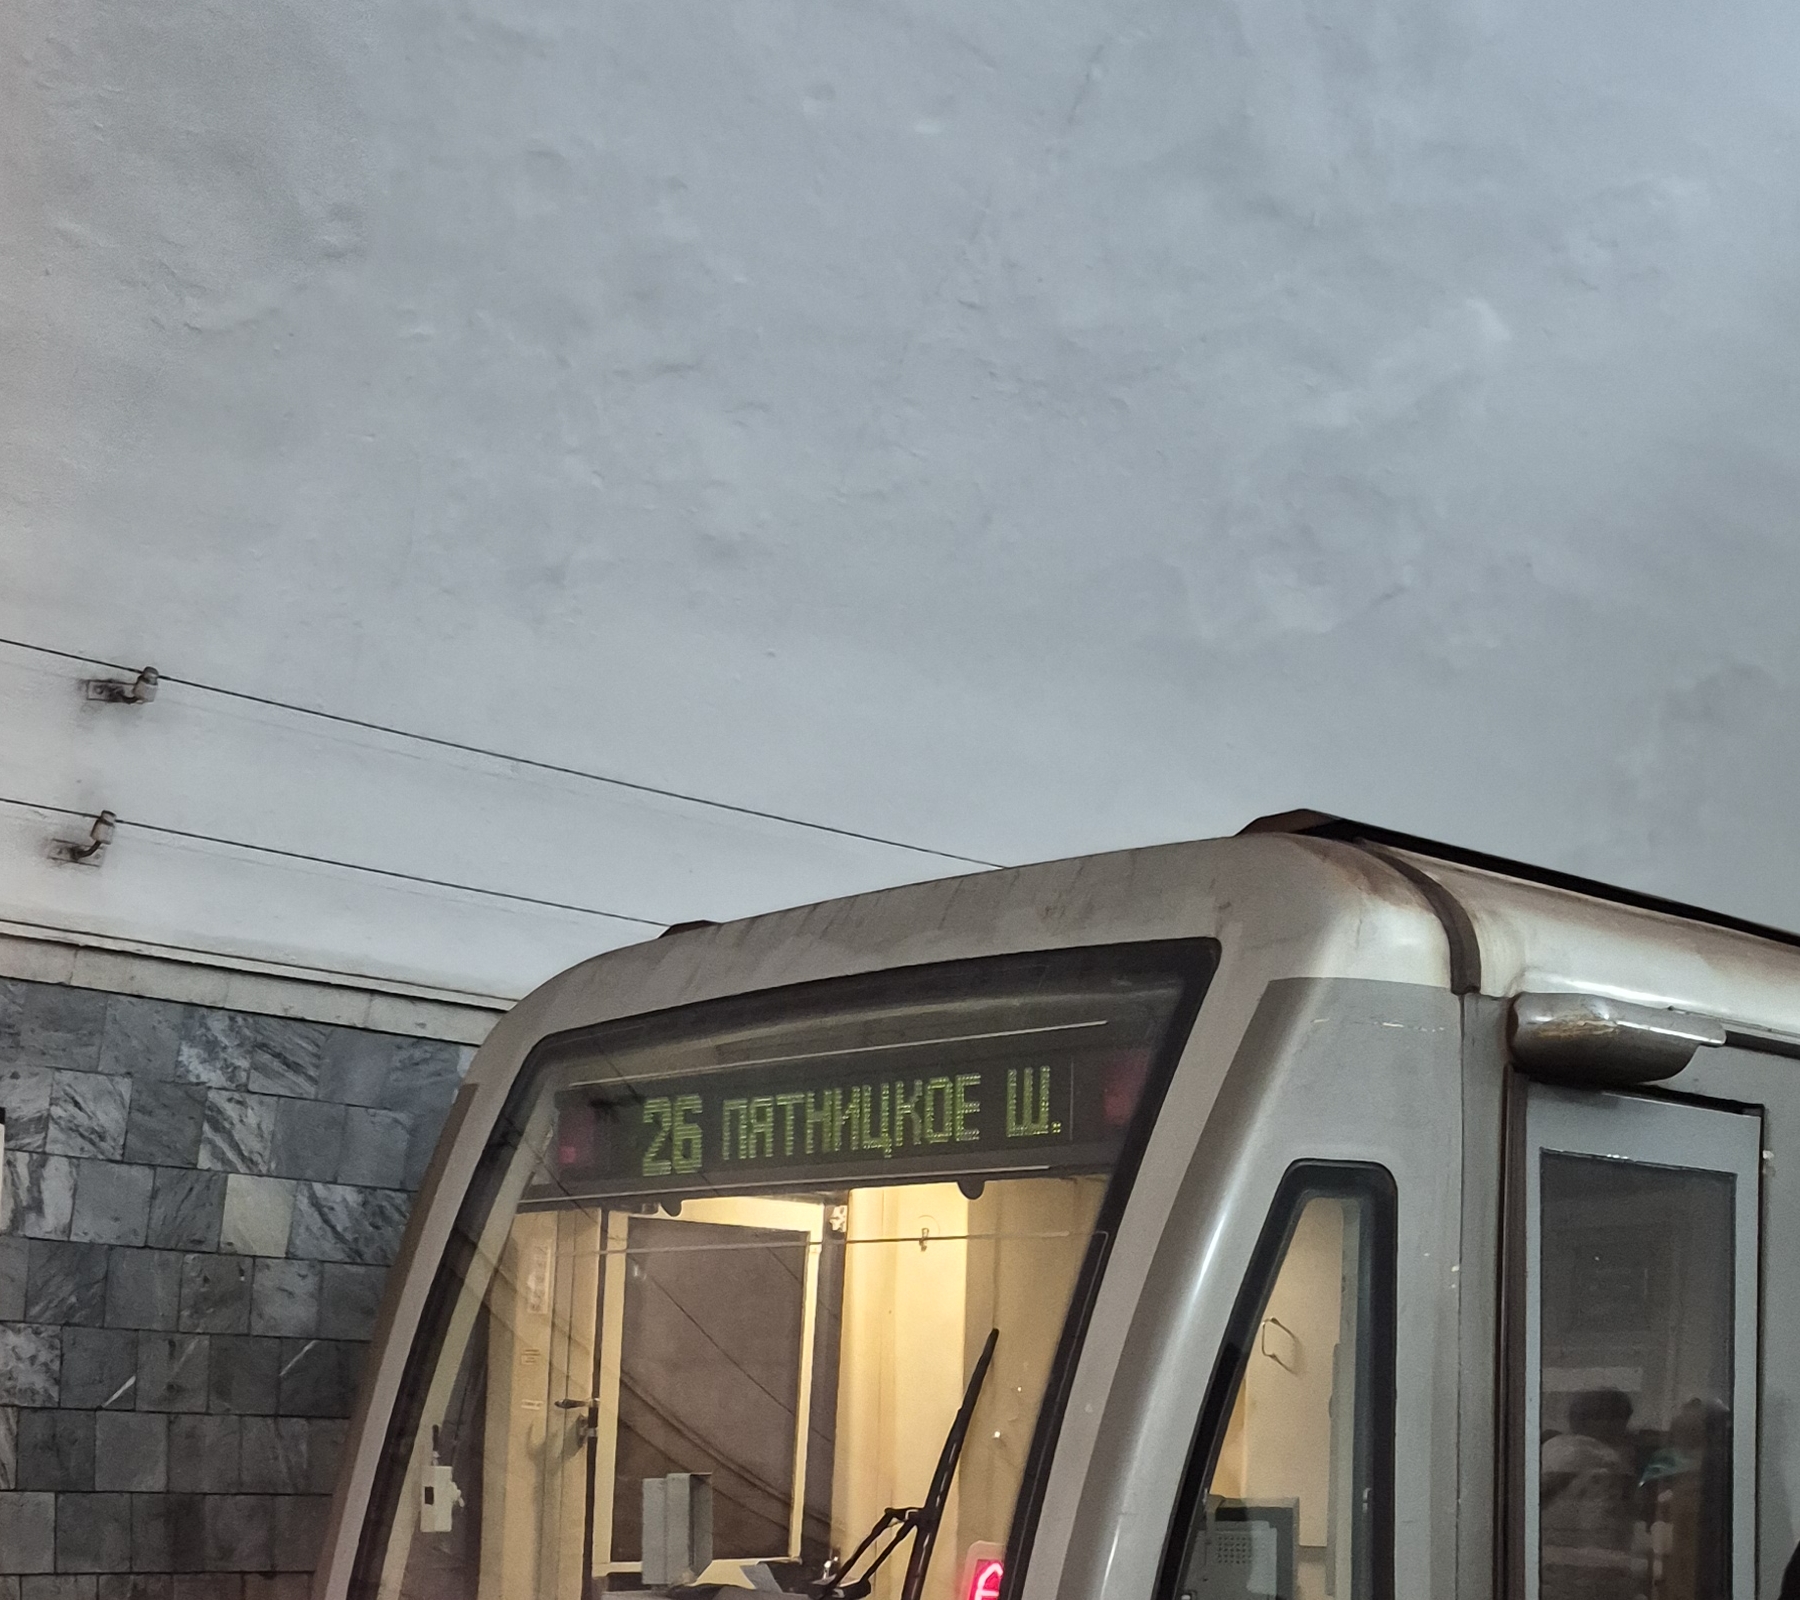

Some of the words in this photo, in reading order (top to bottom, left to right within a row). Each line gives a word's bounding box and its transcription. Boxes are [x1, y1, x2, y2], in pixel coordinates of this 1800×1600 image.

[643, 1094, 703, 1177] 26
[723, 1073, 981, 1160] ПЯТНИЦКОЕ
[1006, 1065, 1062, 1137] Ш.
